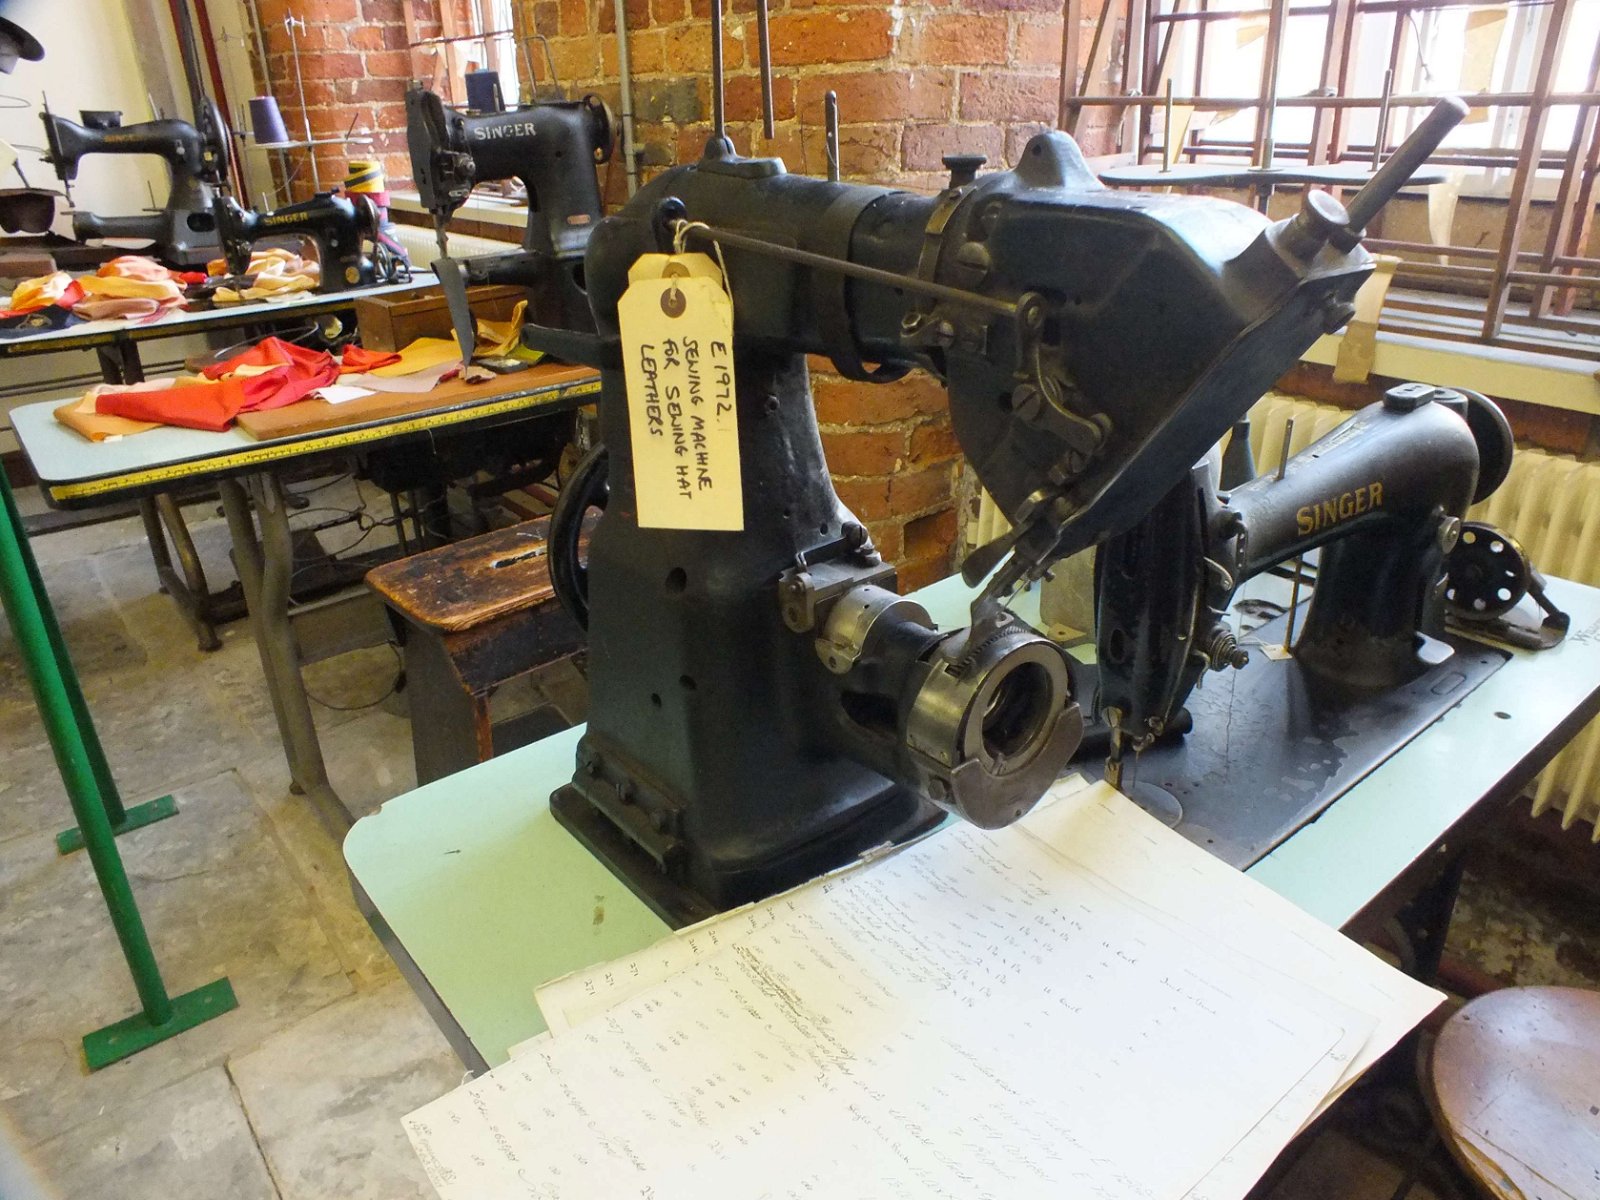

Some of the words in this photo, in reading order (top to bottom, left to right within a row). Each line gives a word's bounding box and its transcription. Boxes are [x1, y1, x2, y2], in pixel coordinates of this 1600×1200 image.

[473, 122, 537, 141] SINGER
[263, 211, 309, 226] SINGER
[662, 338, 681, 370] FOR
[683, 336, 704, 405] SEWING
[640, 344, 663, 436] LEATHERS
[665, 385, 688, 457] SEWING
[690, 415, 712, 491] MACHINE
[676, 465, 692, 499] HAT
[1296, 482, 1383, 536] SINGER
